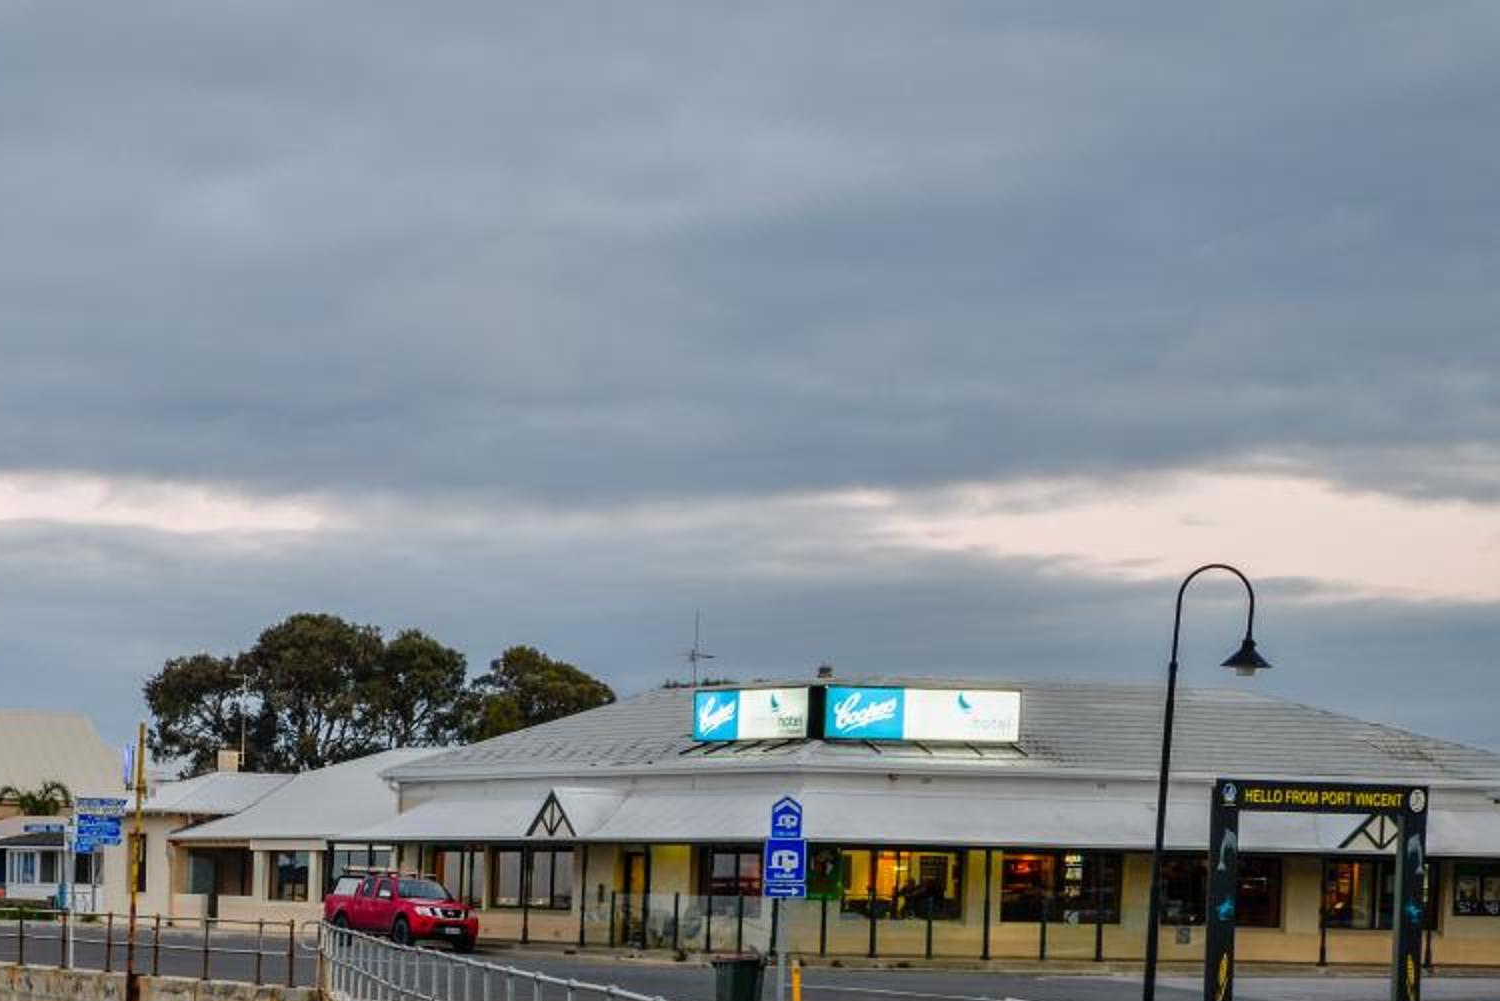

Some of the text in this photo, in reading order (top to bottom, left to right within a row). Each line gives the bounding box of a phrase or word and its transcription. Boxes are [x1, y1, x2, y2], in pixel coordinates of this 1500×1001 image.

[1245, 789, 1404, 808] HELLO FROM PORT VINCENT
